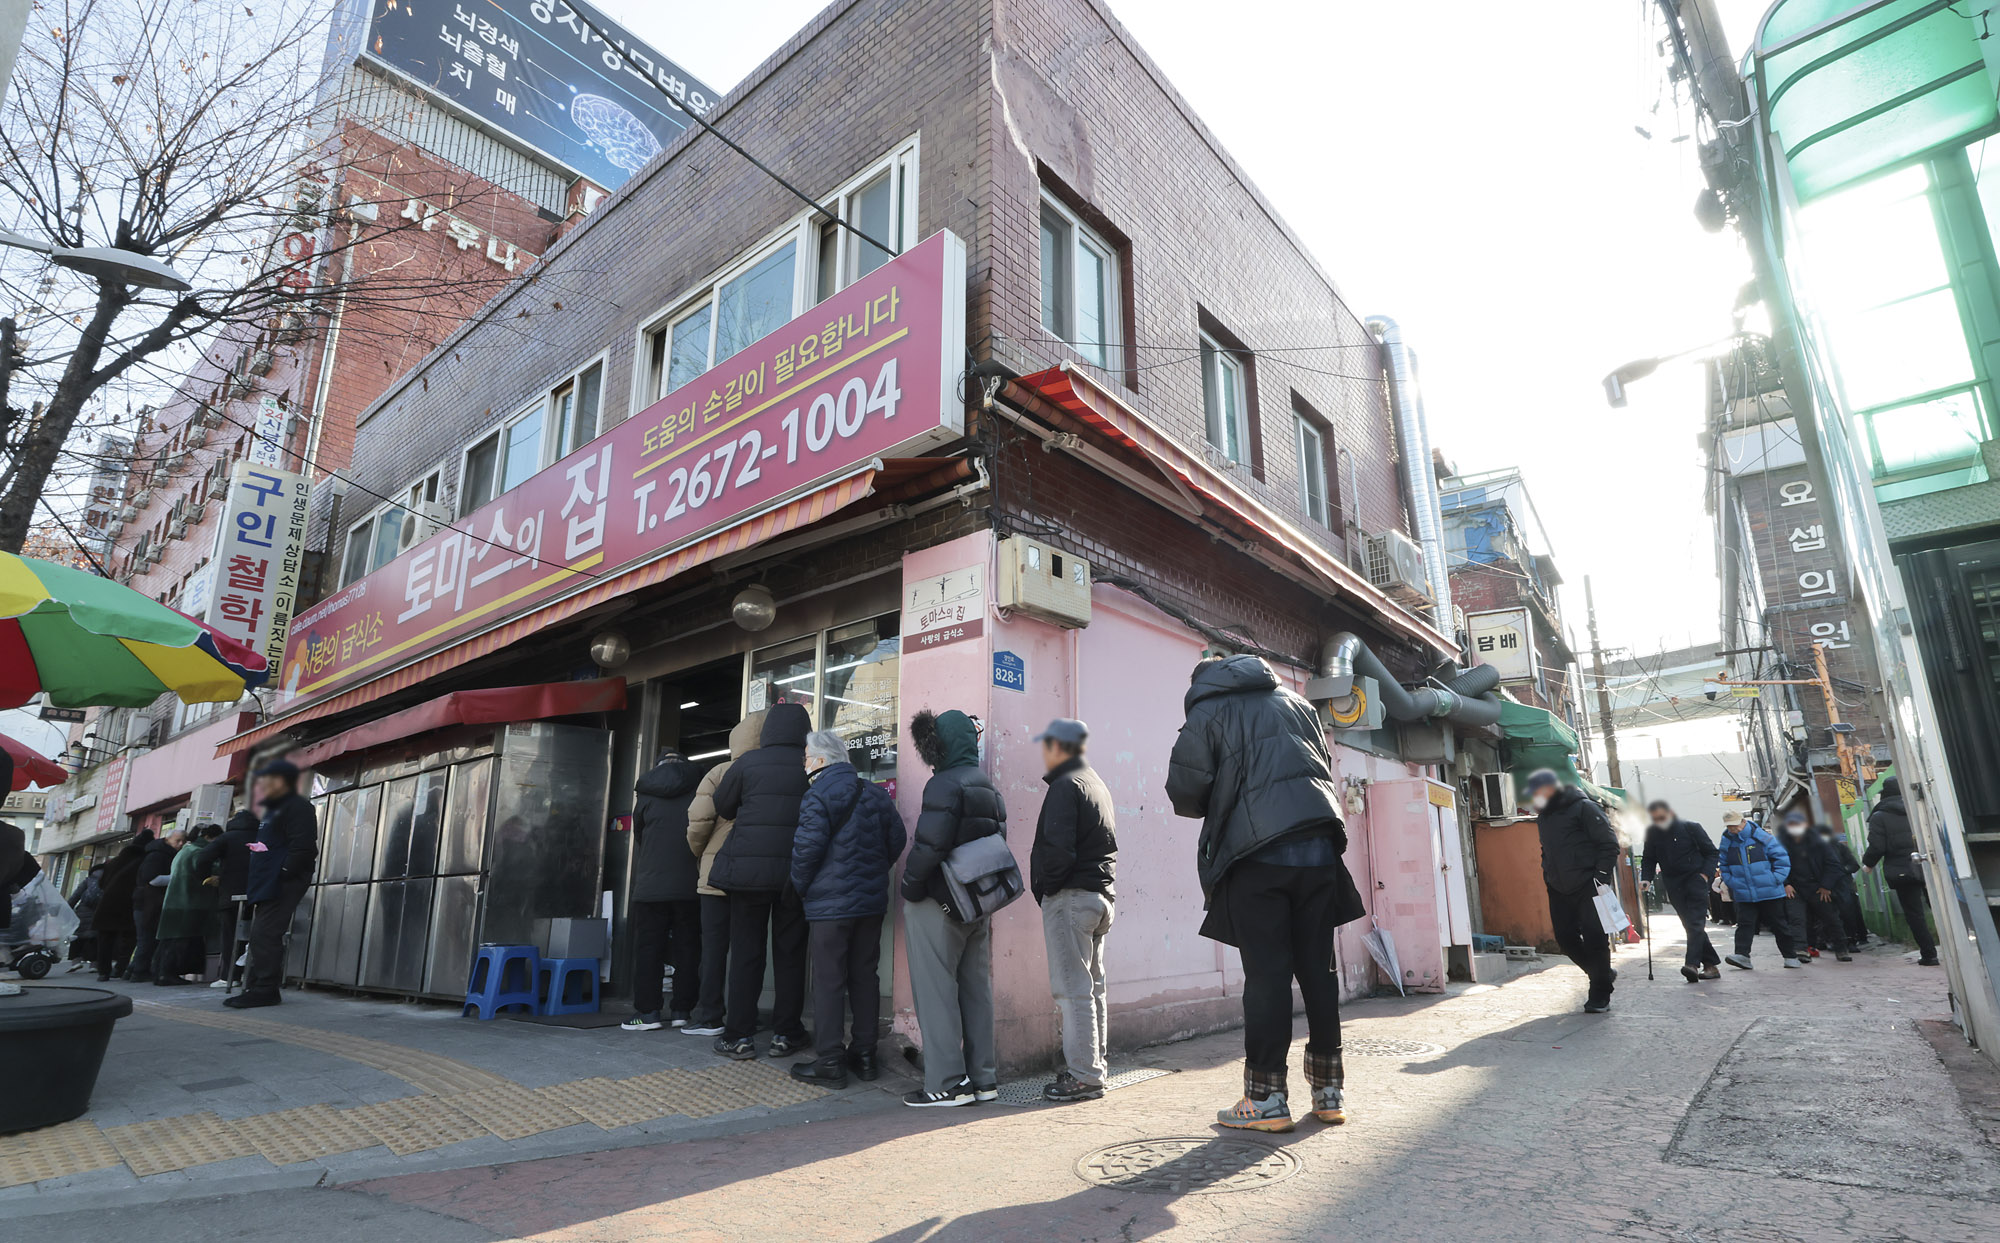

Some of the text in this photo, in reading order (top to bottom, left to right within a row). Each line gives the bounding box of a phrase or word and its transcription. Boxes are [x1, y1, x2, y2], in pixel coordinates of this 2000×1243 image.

[439, 24, 507, 81] 뇌출혈
[453, 3, 519, 61] 뇌경색
[640, 285, 900, 457] 도움의 손길이 필요합니다
[397, 442, 614, 624] 토마스의 집
[1778, 479, 1851, 650] 요셉의원
[305, 611, 384, 678] 사랑의 급식소
[920, 605, 966, 631] 토마스의 집
[920, 627, 964, 645] 사랑의 급식소
[995, 667, 1022, 685] 828-1
[865, 733, 891, 747] 목요일은
